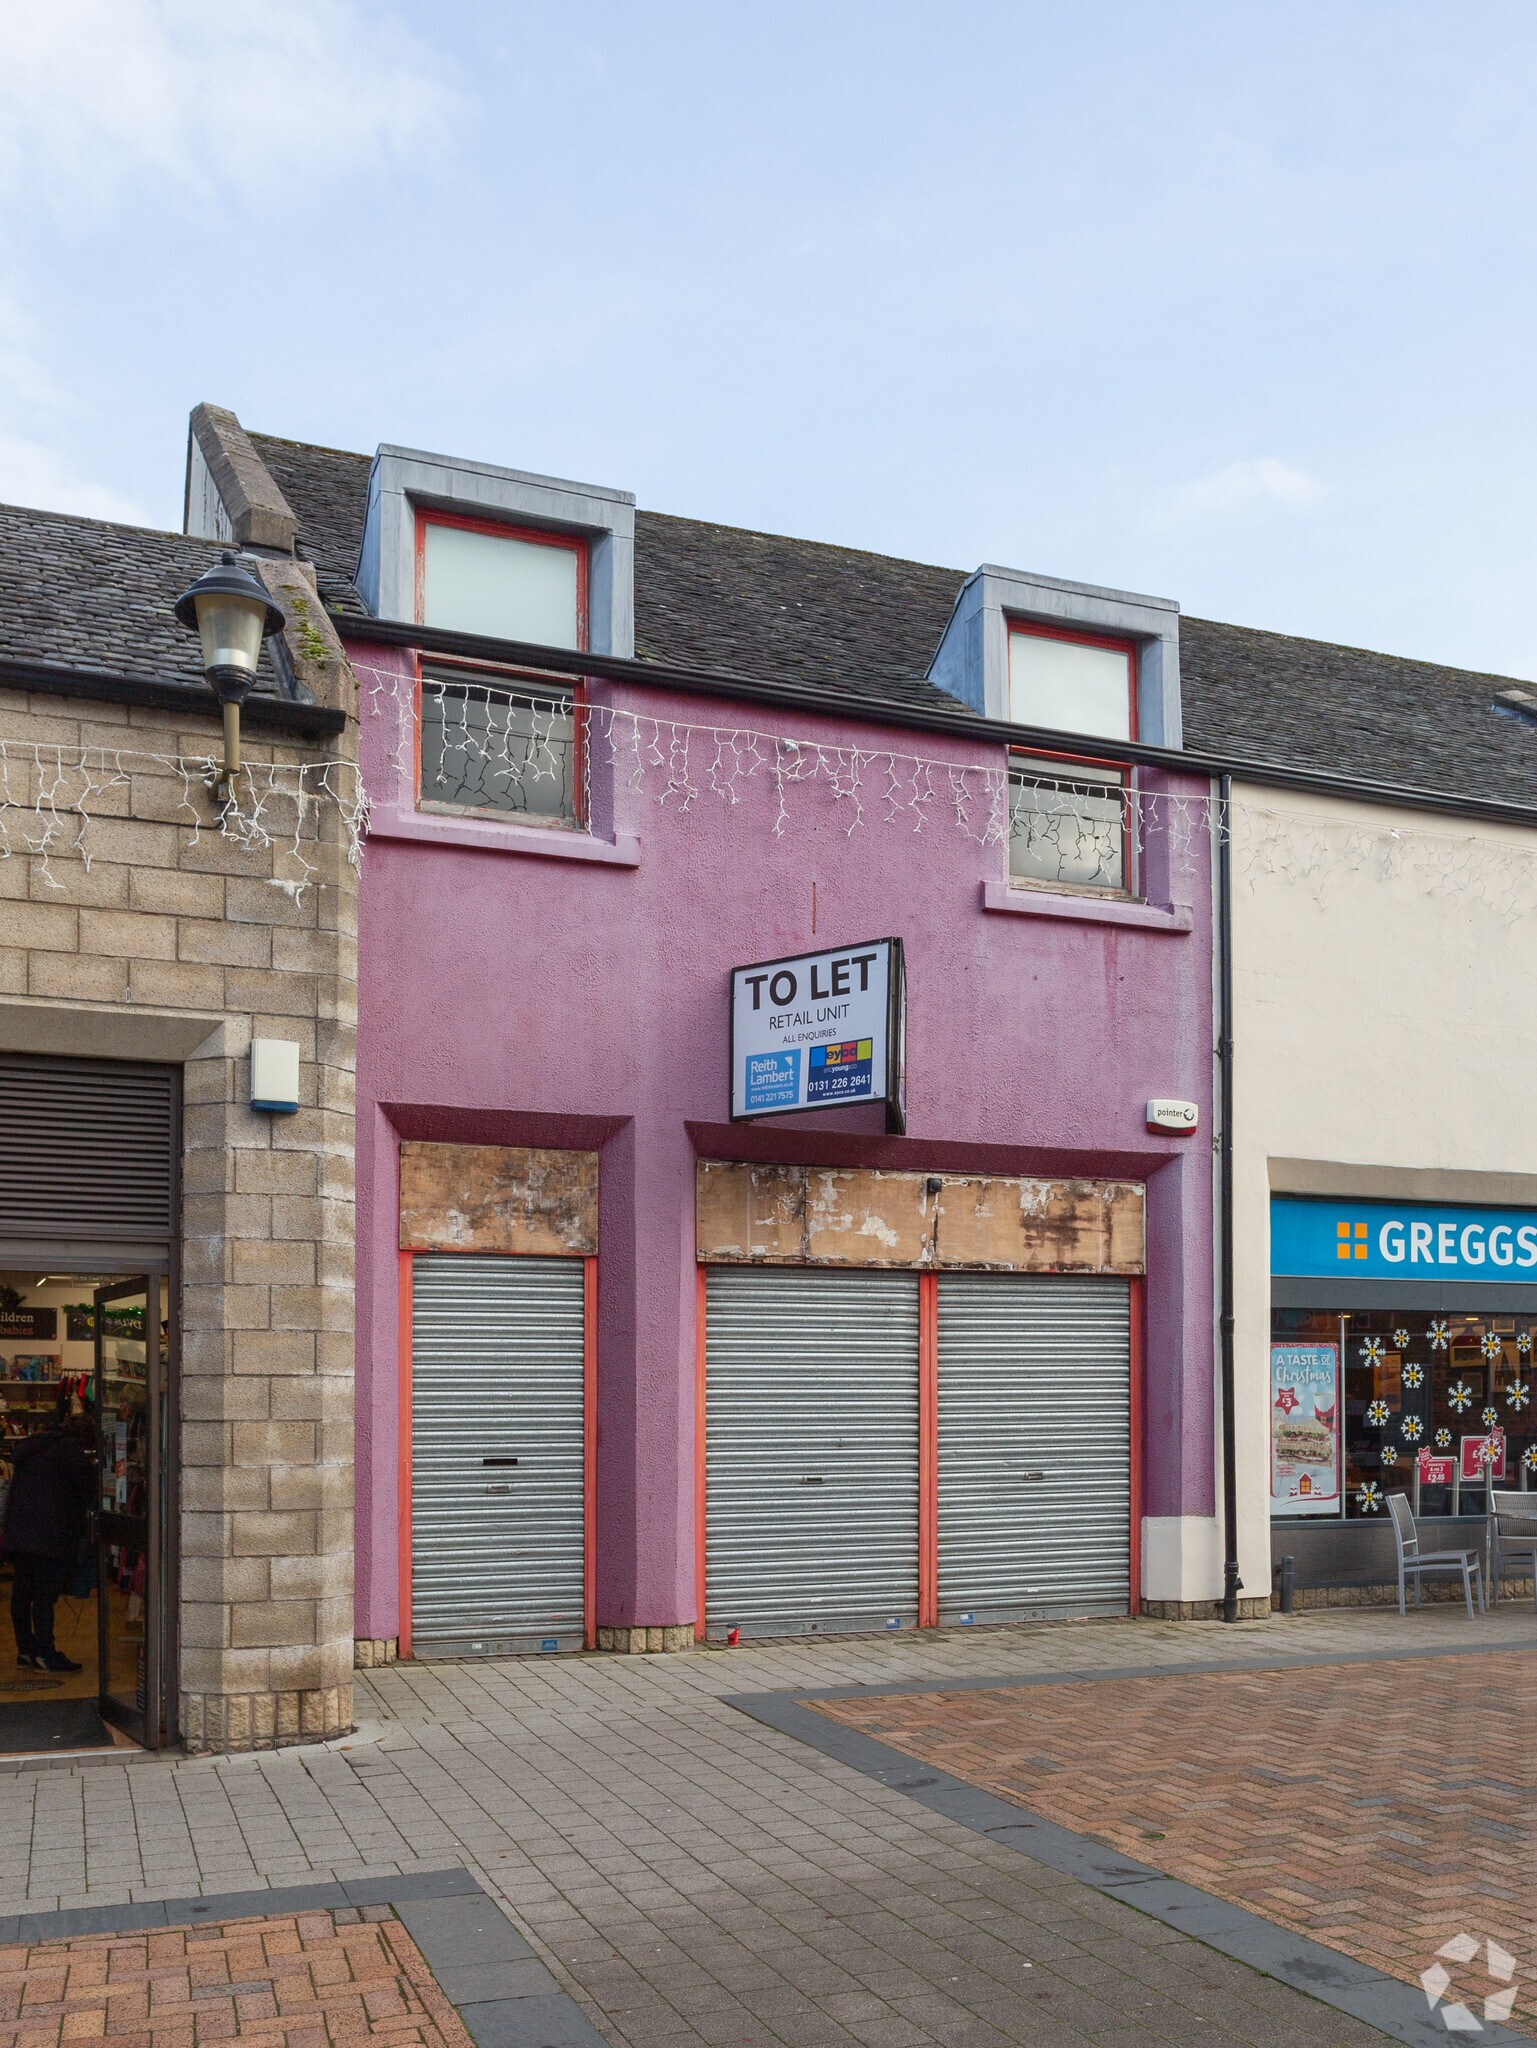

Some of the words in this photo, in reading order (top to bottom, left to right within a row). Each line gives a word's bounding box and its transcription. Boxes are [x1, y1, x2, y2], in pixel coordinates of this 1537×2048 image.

[745, 970, 797, 1010] TO
[810, 953, 877, 1000] LET
[769, 1011, 813, 1030] RETAIL
[816, 1004, 850, 1021] UNIT
[782, 1035, 796, 1044] ALL
[798, 1028, 837, 1042] ENQUIRIES
[826, 1048, 857, 1061] eyco
[751, 1059, 777, 1073] Reith
[750, 1068, 794, 1085] Lambert
[808, 1080, 829, 1092] 0131
[831, 1077, 848, 1089] 226
[850, 1074, 871, 1087] 2641
[750, 1094, 765, 1104] 0141
[765, 1092, 777, 1102] 221
[777, 1090, 794, 1100] 7575
[1157, 1108, 1183, 1117] pointer
[1379, 1220, 1537, 1267] GREGGS
[1277, 1355, 1285, 1365] A
[1287, 1355, 1317, 1365] TASTE
[1321, 1355, 1331, 1365] OF
[1276, 1365, 1331, 1384] Christmas
[1282, 1398, 1292, 1407] £3
